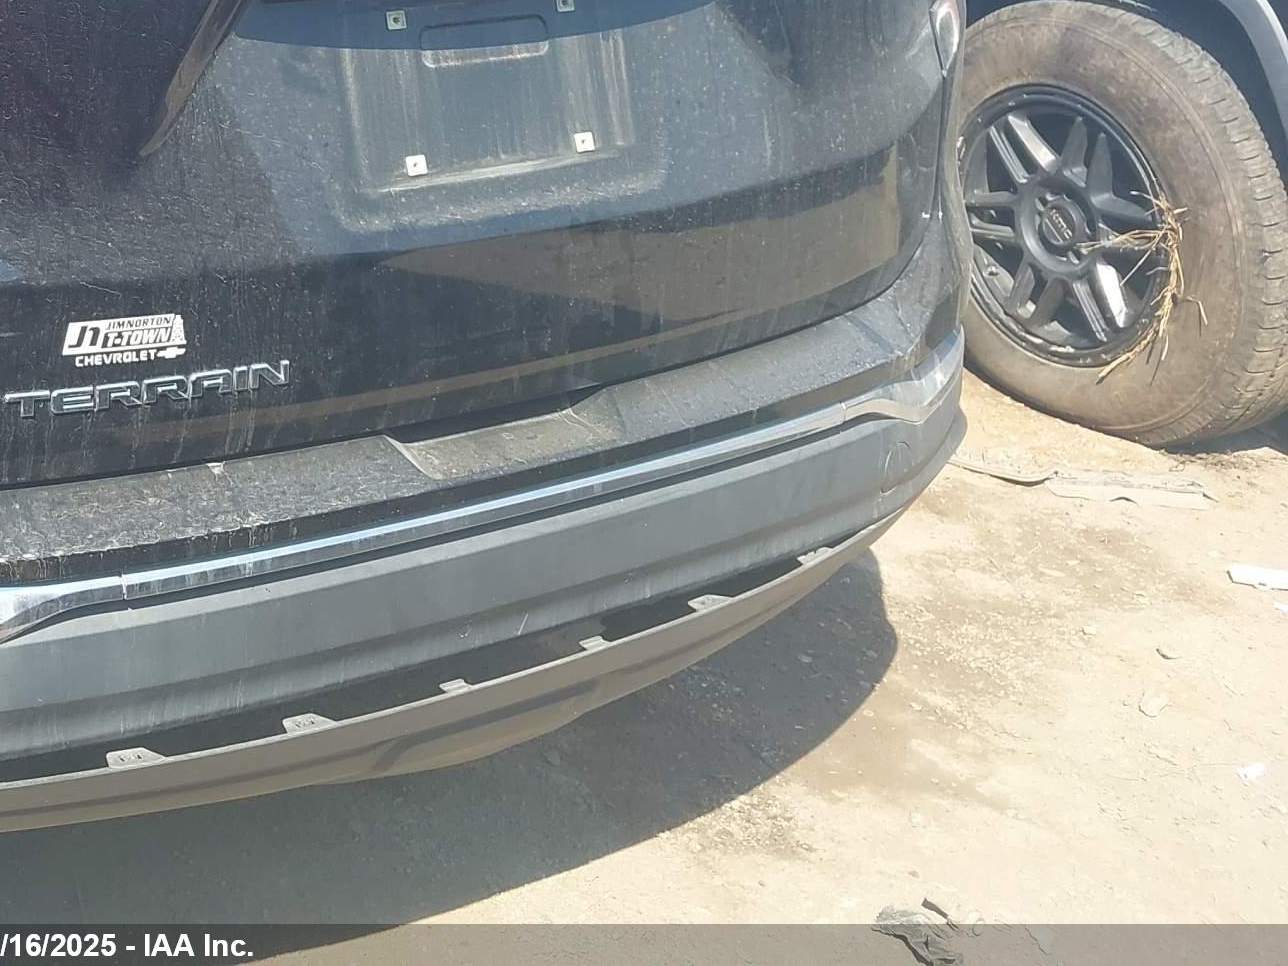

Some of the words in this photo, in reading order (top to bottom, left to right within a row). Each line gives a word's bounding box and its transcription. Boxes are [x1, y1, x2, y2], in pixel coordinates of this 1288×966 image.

[106, 327, 171, 348] T-TOWN
[75, 349, 157, 367] CHEVROLET
[2, 360, 290, 418] TERRAIN
